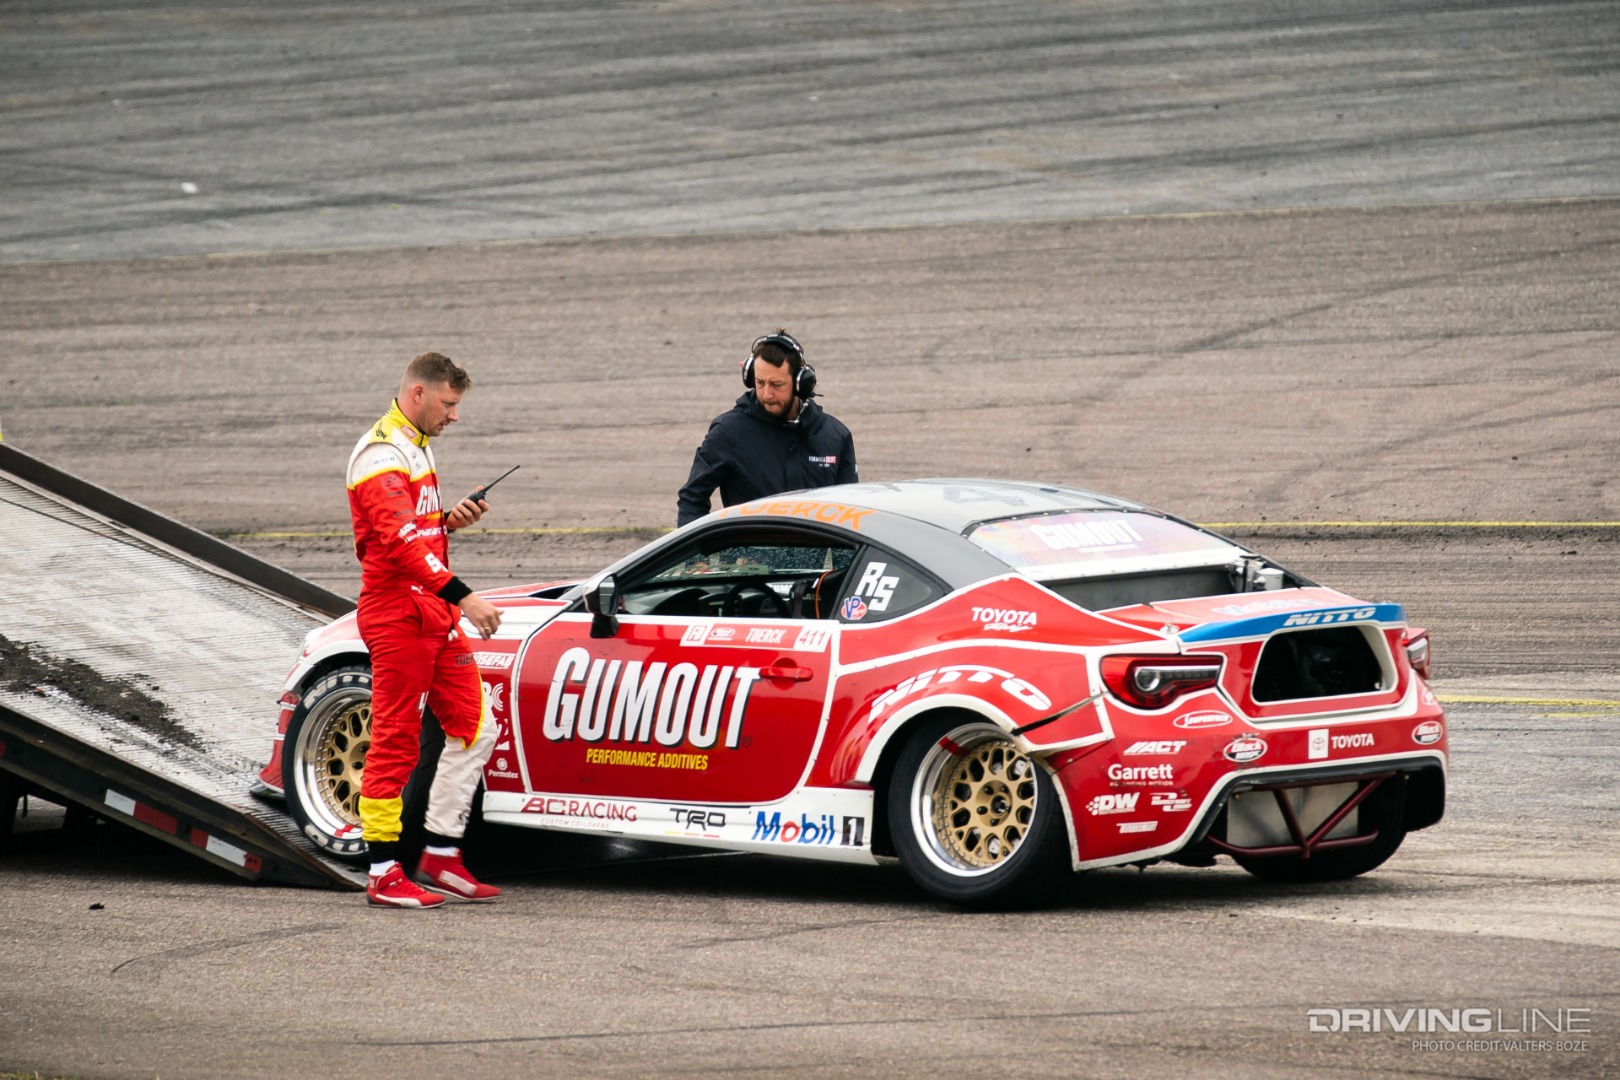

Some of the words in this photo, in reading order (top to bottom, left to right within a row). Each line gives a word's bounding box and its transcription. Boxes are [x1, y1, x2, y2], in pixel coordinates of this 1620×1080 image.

[1030, 520, 1144, 551] GUMOUT
[854, 562, 900, 612] RS
[844, 596, 862, 619] VP
[971, 606, 1038, 626] TOYOTA
[1284, 607, 1376, 627] NITTO
[745, 628, 787, 644] TUERCK
[799, 629, 828, 646] 411
[542, 646, 762, 749] GUMOUT
[868, 664, 1052, 723] NITTO
[1331, 733, 1375, 749] TOYOTA
[586, 748, 656, 768] PERFORMANCE
[657, 753, 709, 771] ADDITIVES
[1108, 763, 1173, 780] Garrett
[1100, 792, 1140, 811] DW
[669, 807, 726, 831] TRD
[751, 811, 835, 845] Mobil
[846, 817, 859, 846] 1
